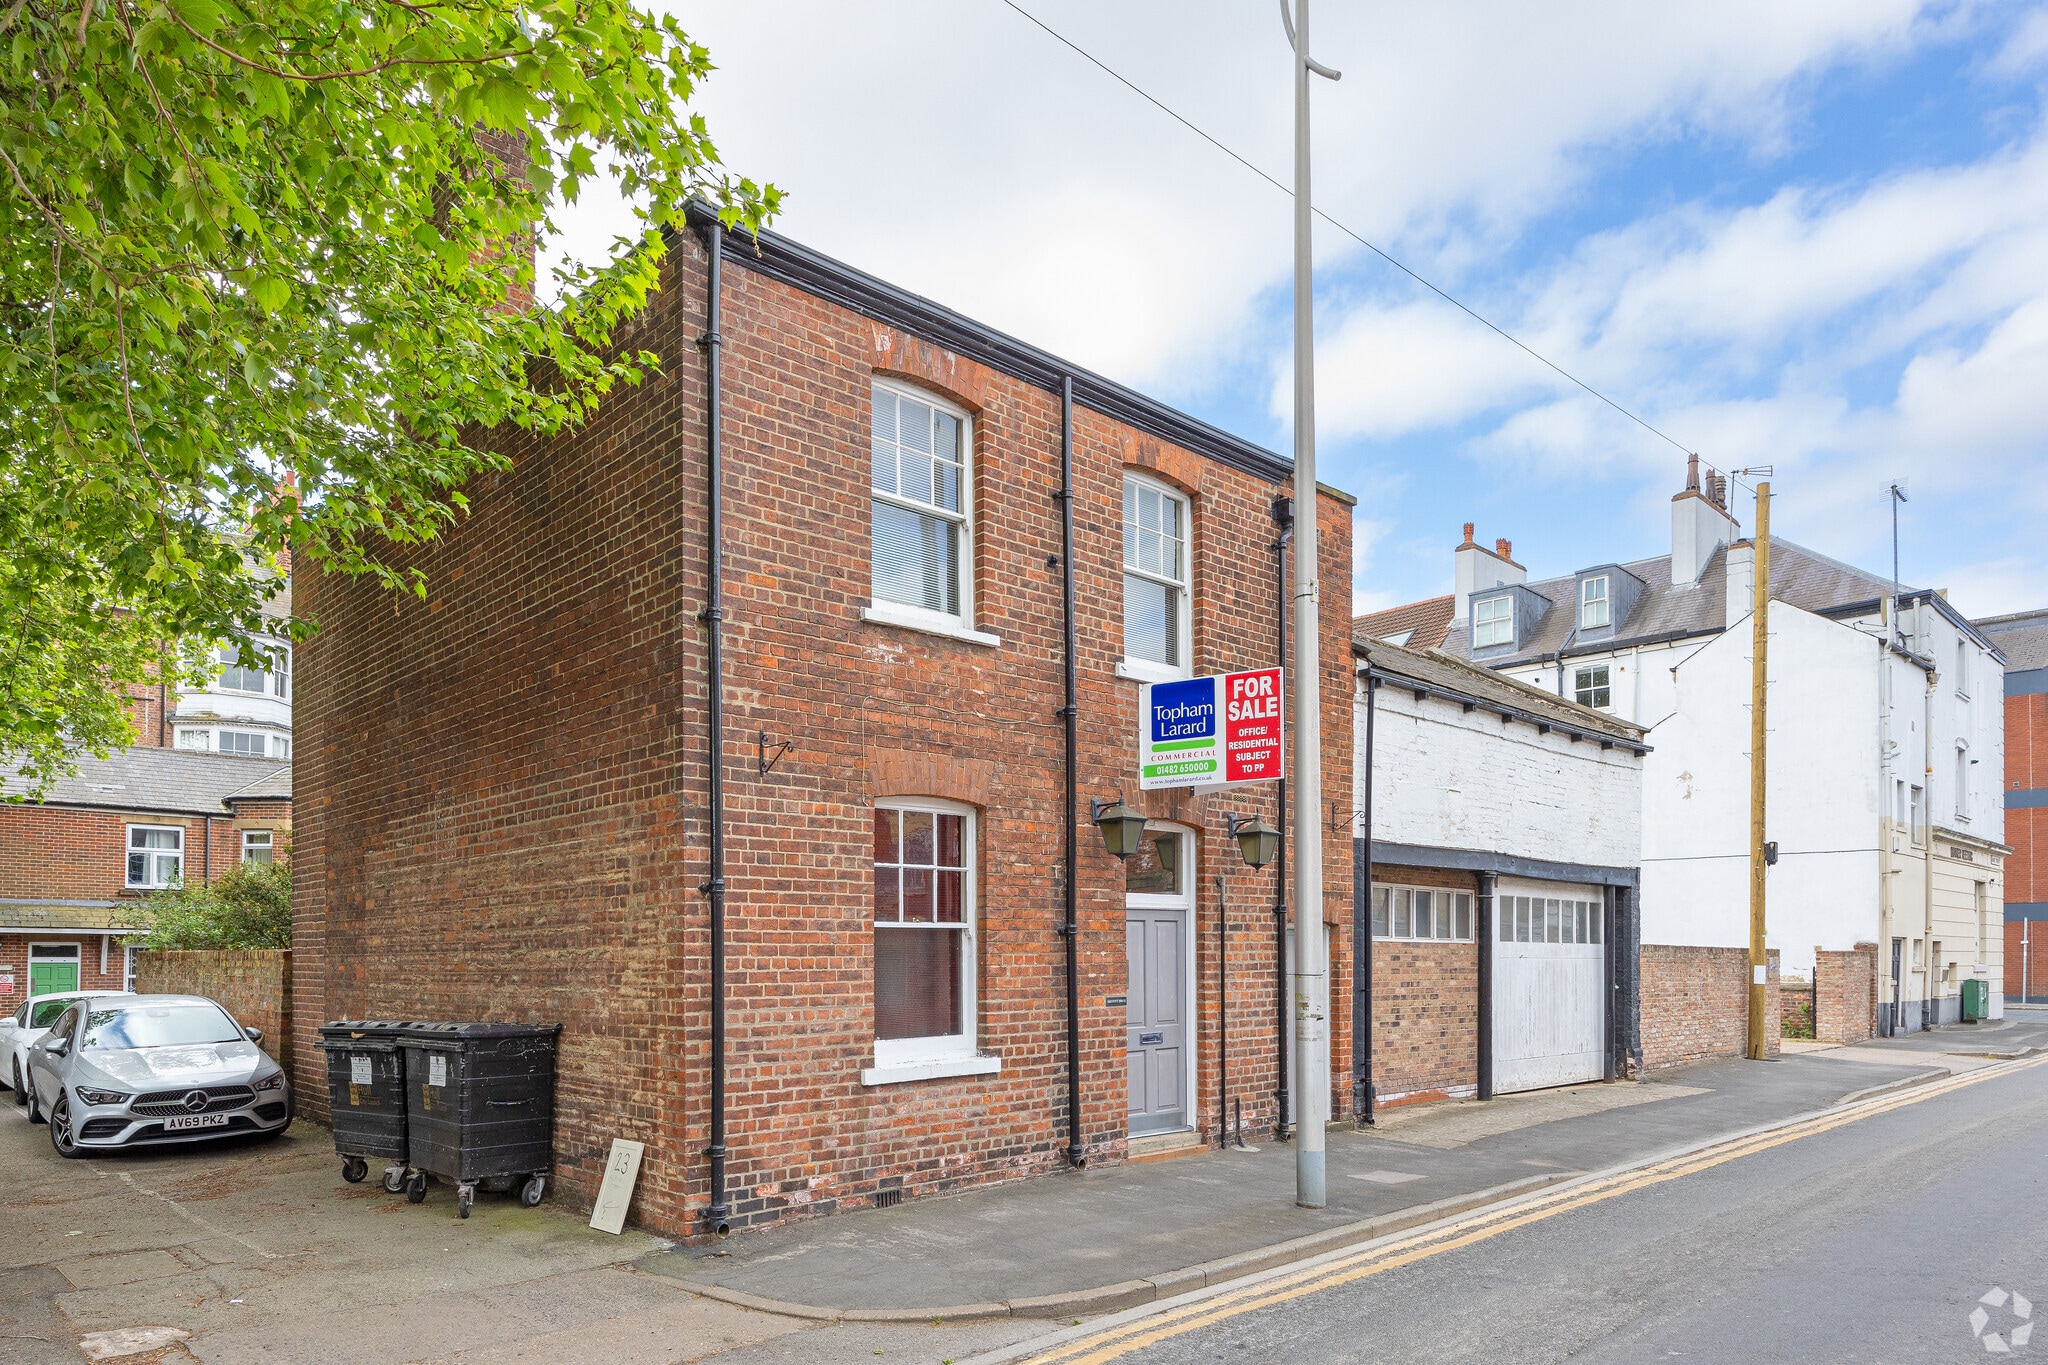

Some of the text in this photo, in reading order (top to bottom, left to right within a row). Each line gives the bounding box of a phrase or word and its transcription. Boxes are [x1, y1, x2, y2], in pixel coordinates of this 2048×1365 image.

[1233, 675, 1273, 699] FOR
[1154, 702, 1213, 723] Topham
[1228, 696, 1278, 722] SALE
[1161, 717, 1207, 737] Larard
[1238, 726, 1268, 737] OFFICE/
[1228, 737, 1279, 750] RESIDENTIAL
[1151, 750, 1216, 762] COMMERCIAL
[1235, 750, 1271, 762] SUBJECT
[1156, 762, 1209, 775] 01482 650000
[1242, 763, 1265, 773] TO PP
[1150, 775, 1212, 785] www.tophamlarard.co.uk
[169, 1114, 224, 1128] AV69 PKZ
[614, 1152, 631, 1174] 23
